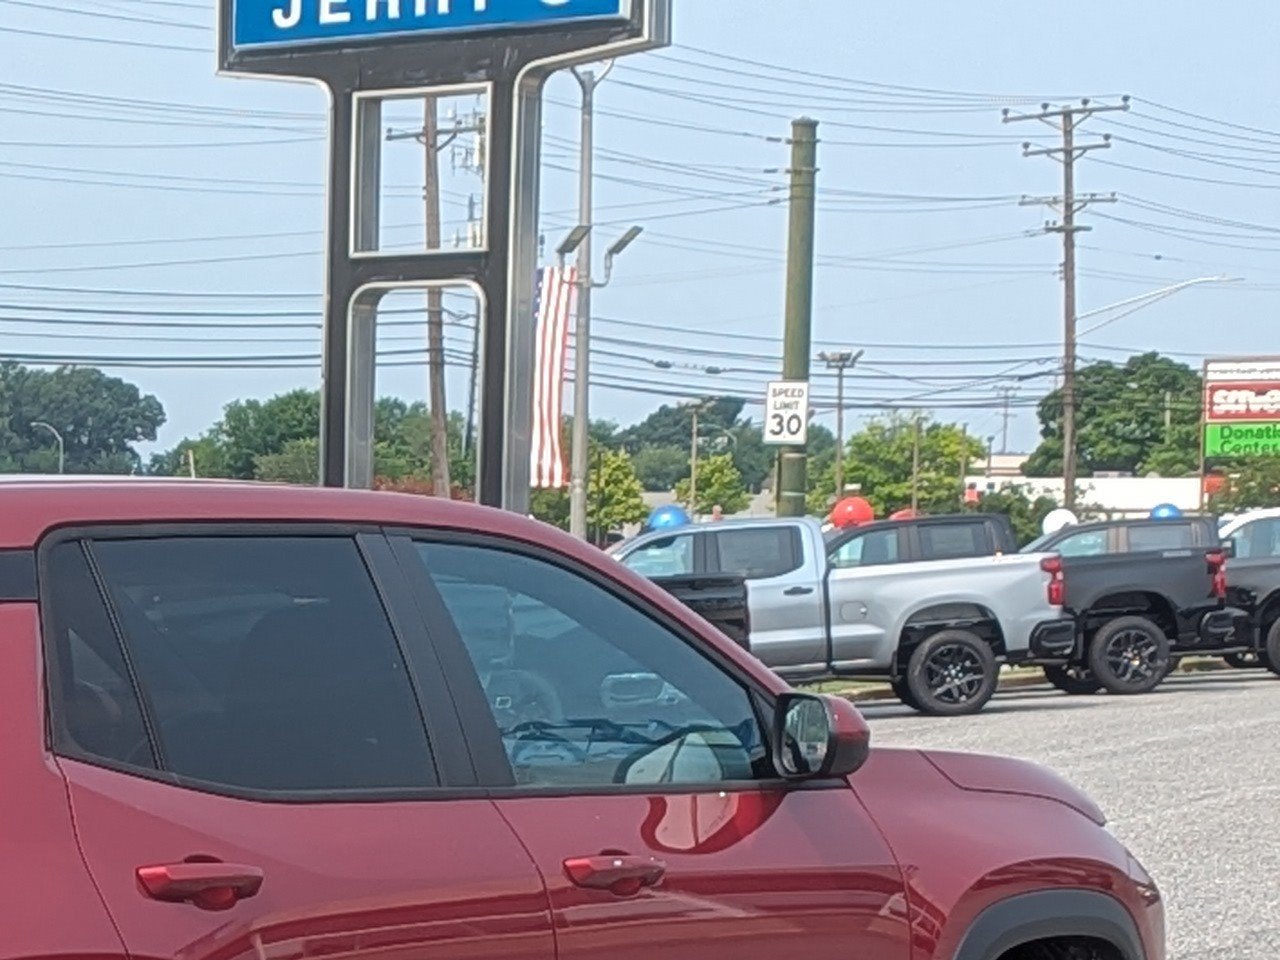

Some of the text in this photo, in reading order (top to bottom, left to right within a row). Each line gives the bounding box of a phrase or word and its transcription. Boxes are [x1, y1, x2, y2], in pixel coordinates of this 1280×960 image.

[772, 387, 804, 398] SPEED
[773, 400, 799, 411] LIMIT
[770, 413, 802, 435] 30
[1221, 424, 1280, 439] Donati
[1221, 440, 1278, 454] Center
